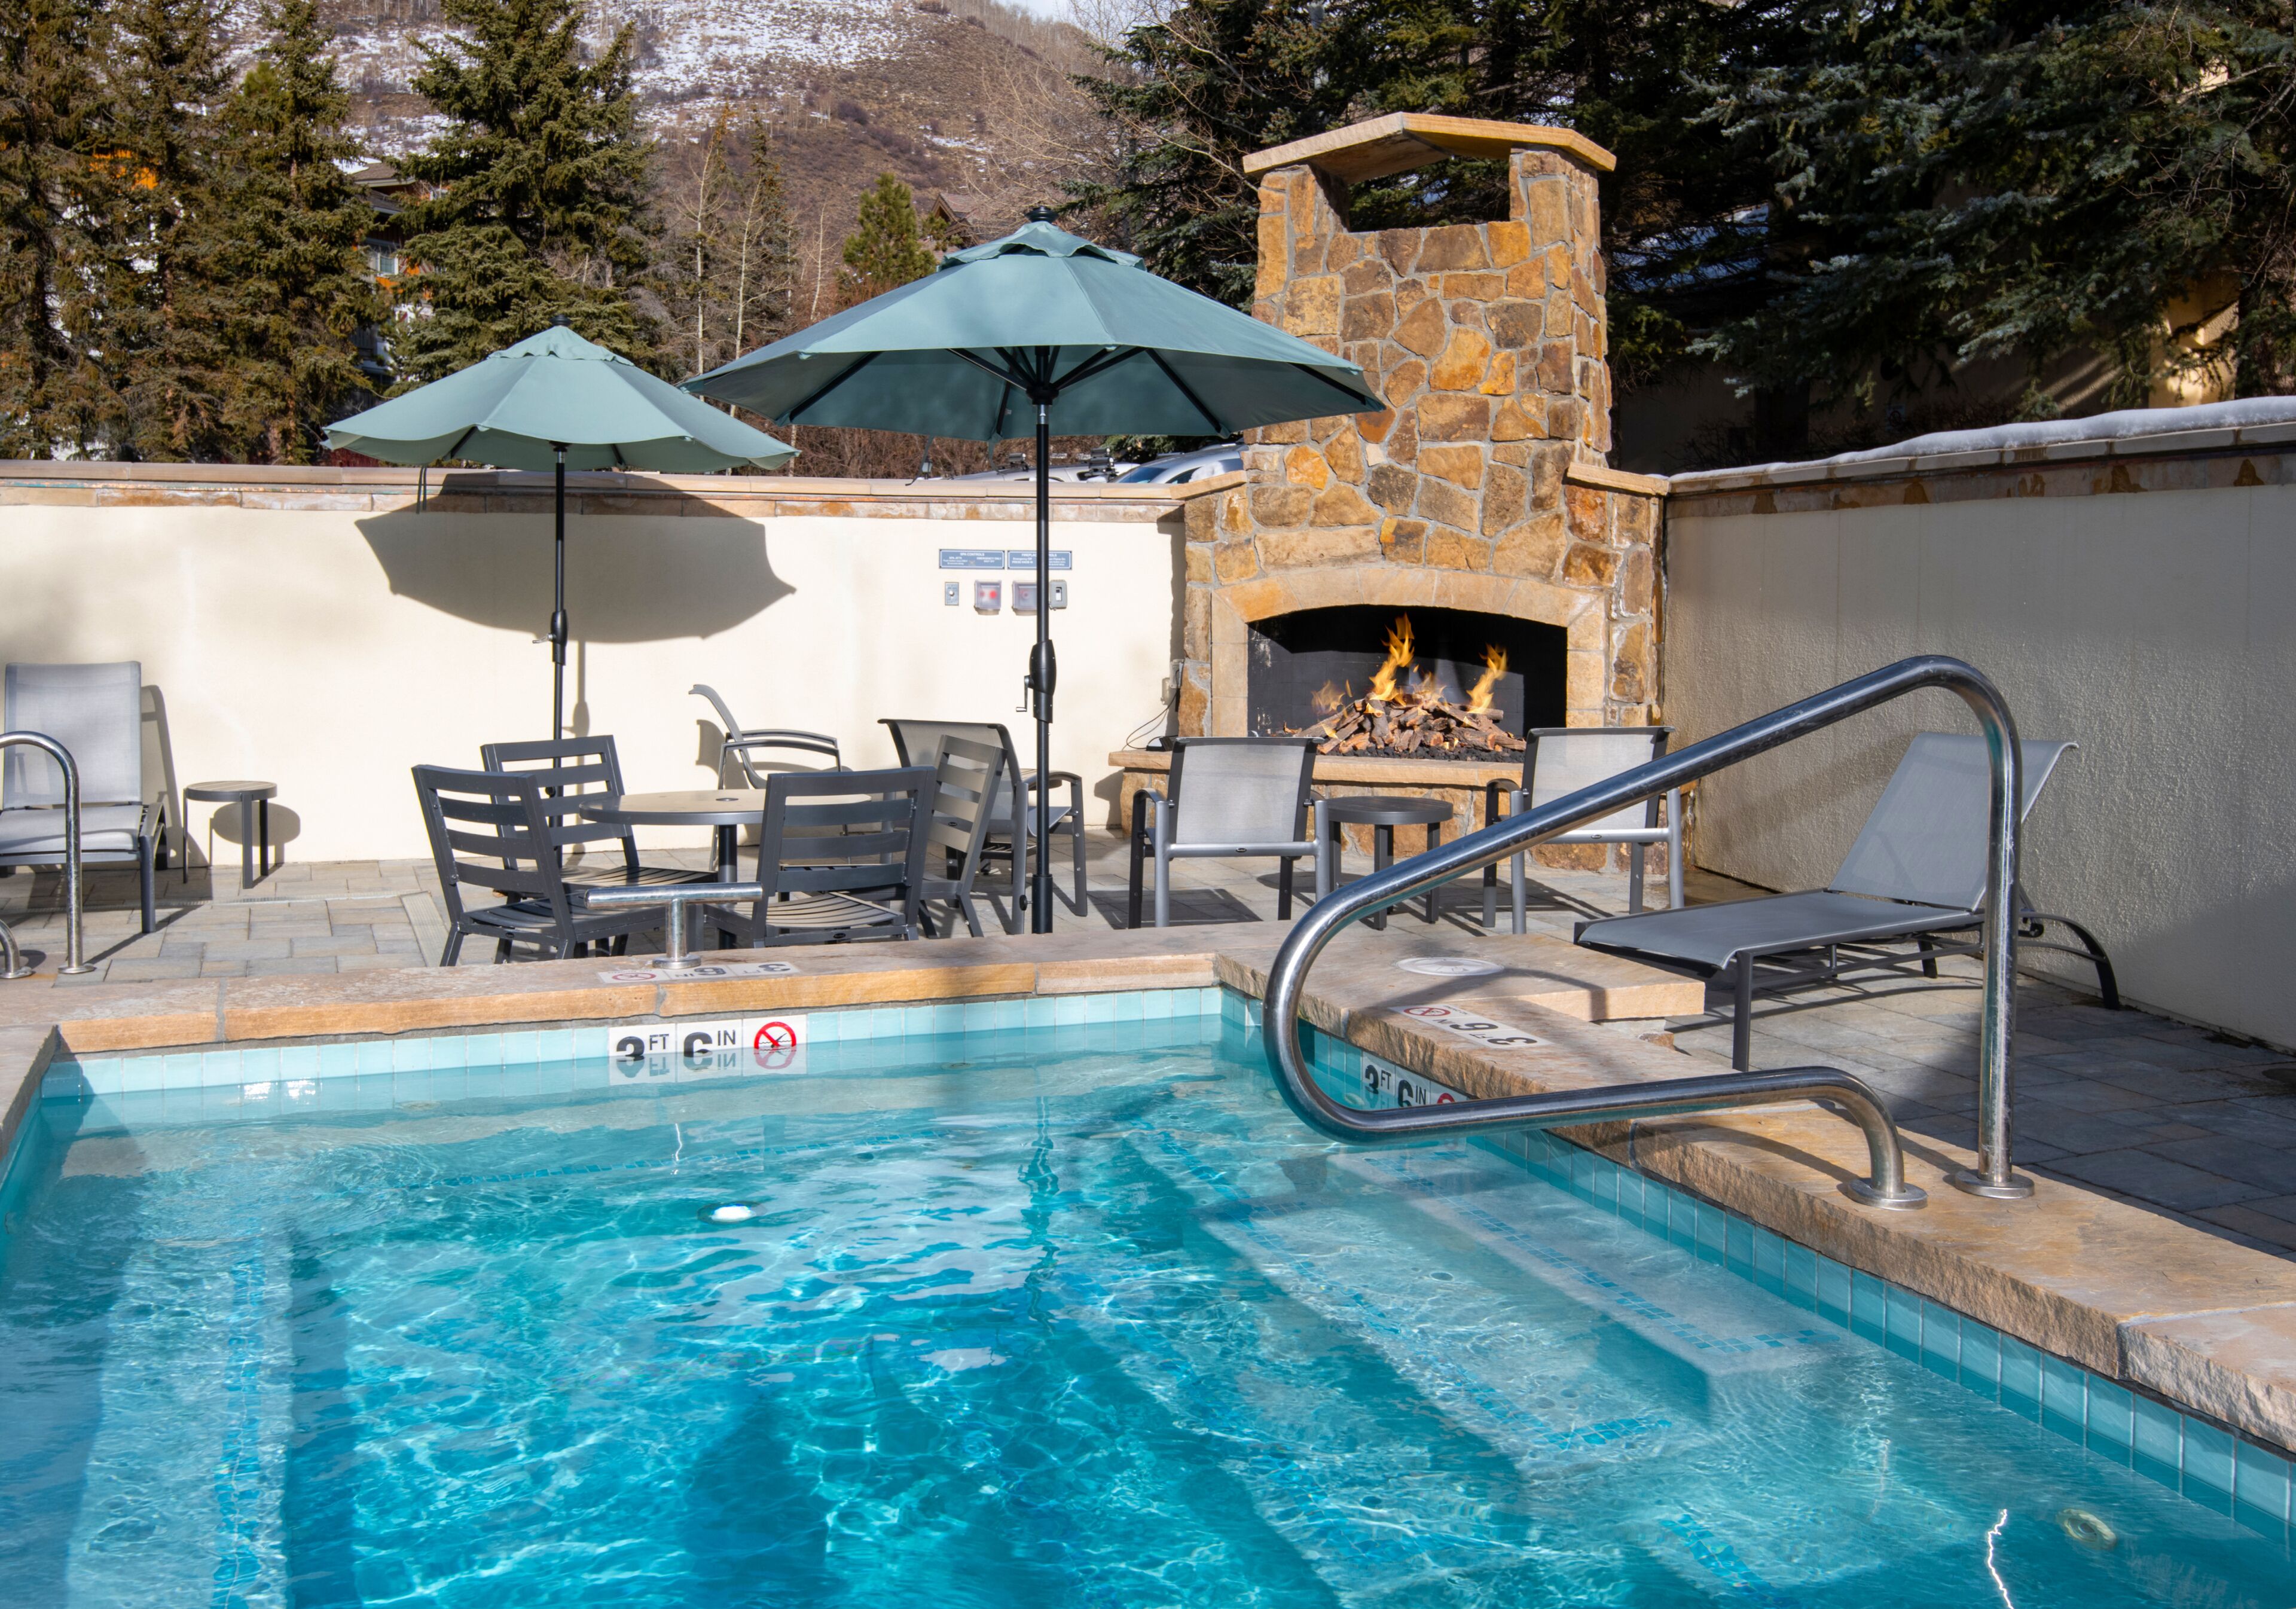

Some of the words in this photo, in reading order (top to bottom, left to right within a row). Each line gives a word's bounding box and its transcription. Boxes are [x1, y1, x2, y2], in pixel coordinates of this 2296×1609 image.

[694, 967, 726, 975] 6
[758, 963, 791, 972] 3
[1449, 1022, 1498, 1031] 6
[649, 1034, 669, 1051] FT
[718, 1029, 736, 1046] IN
[1487, 1037, 1538, 1045] 3
[1381, 1070, 1391, 1089] FT
[1398, 1079, 1413, 1107] 6
[1415, 1085, 1426, 1106] IN
